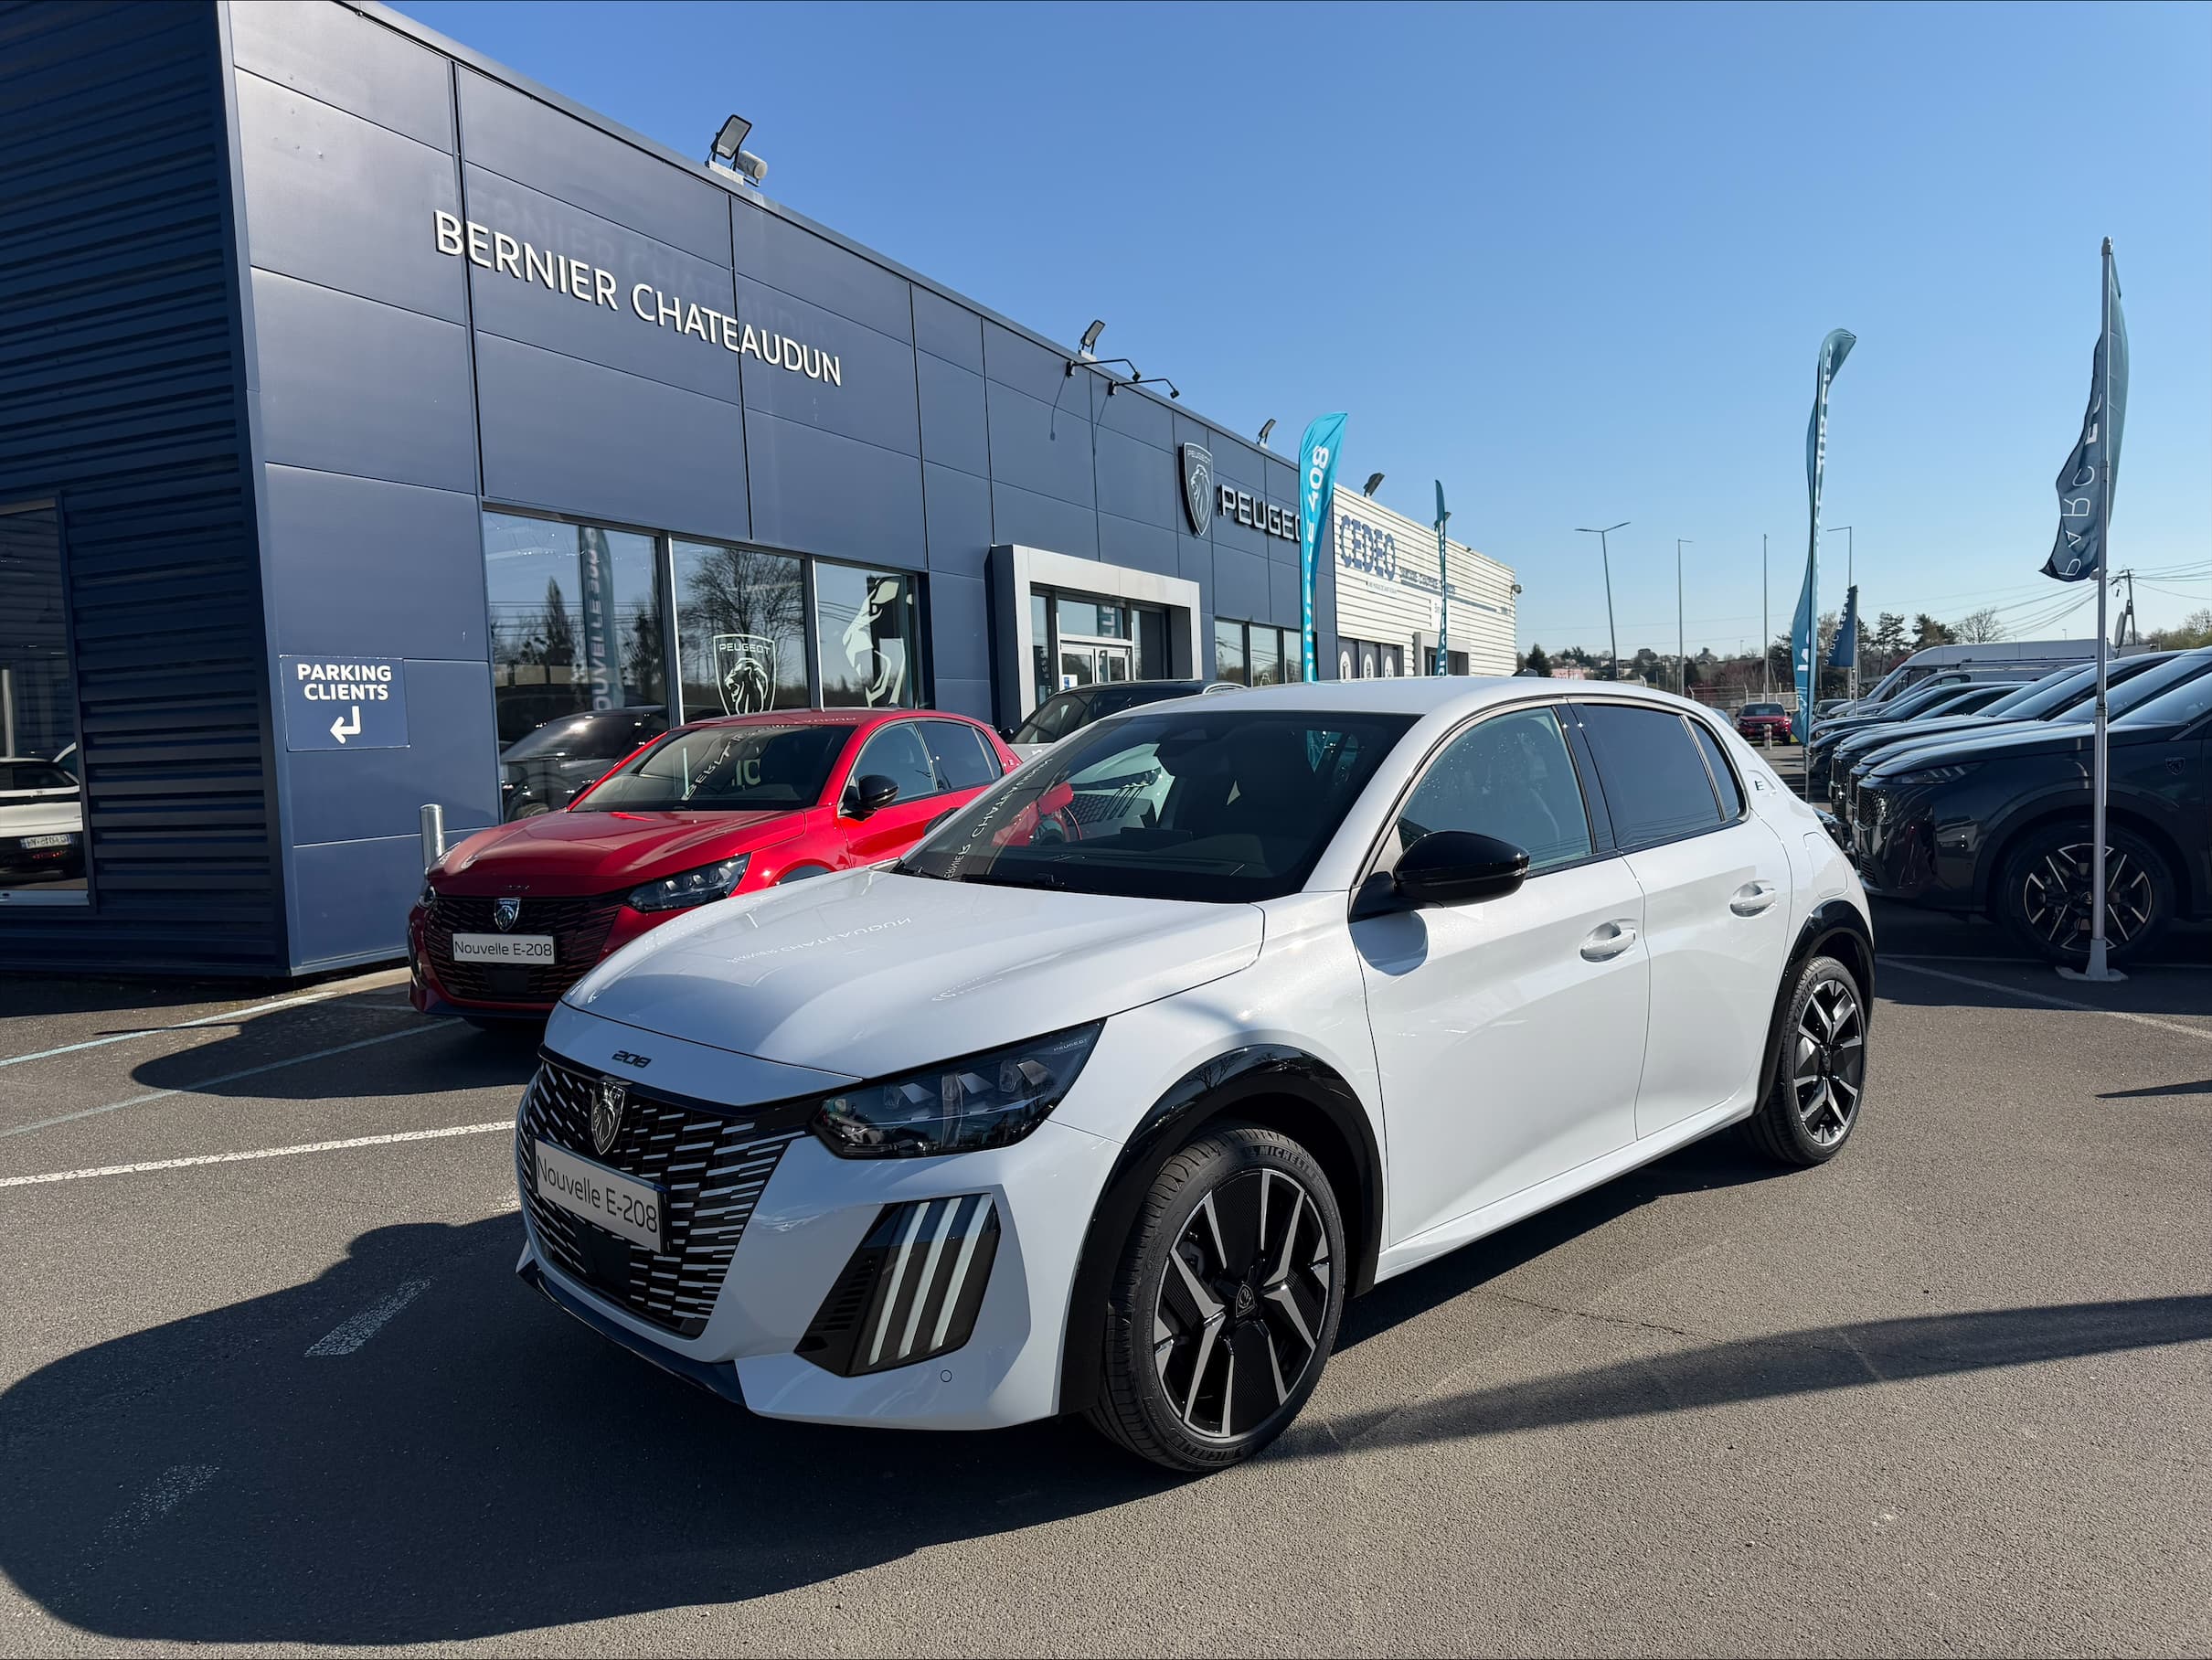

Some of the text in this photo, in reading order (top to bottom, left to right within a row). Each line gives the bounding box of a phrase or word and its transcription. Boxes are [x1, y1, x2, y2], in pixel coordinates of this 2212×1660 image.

[434, 210, 841, 387] BERNIER CHATEAUDUN
[1308, 446, 1330, 512] 408
[1340, 514, 1396, 581] CEDEO
[718, 642, 771, 654] PEUGEOT
[297, 664, 392, 682] PARKING
[303, 683, 388, 700] CLIENTS
[455, 941, 552, 957] Nouvelle E-208
[611, 1050, 653, 1068] 208
[1259, 1145, 1316, 1179] MICHELIN
[537, 1155, 658, 1234] Nouvelle E-208
